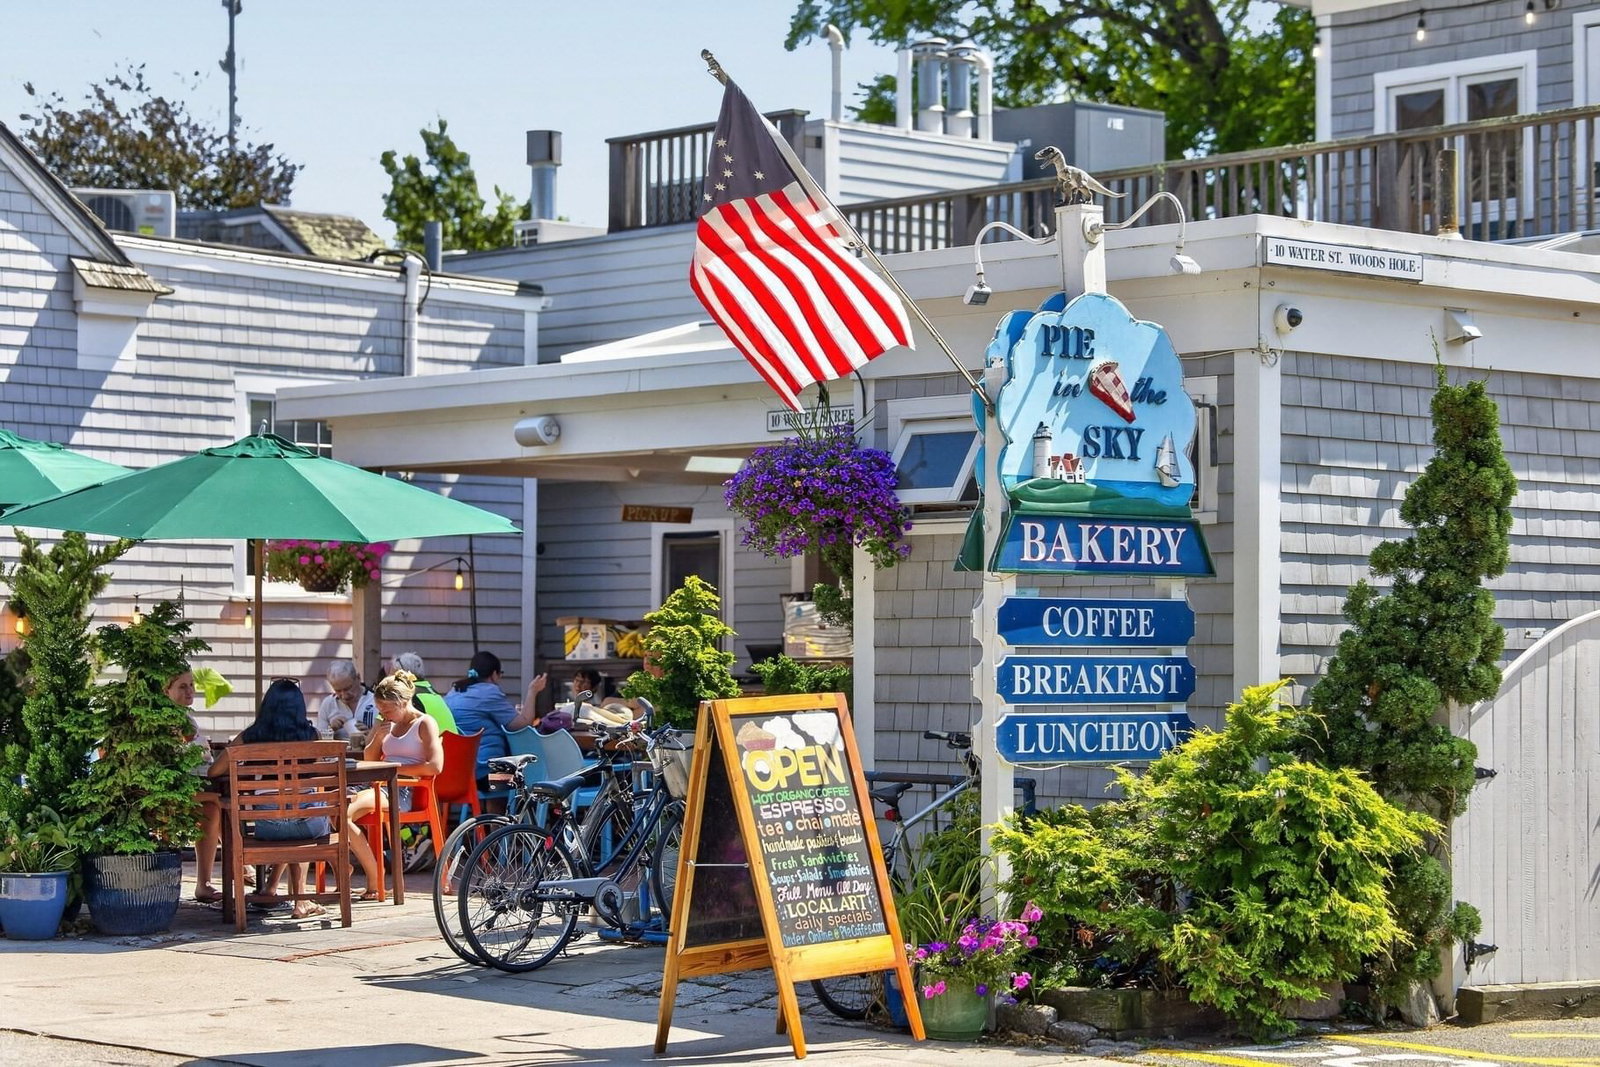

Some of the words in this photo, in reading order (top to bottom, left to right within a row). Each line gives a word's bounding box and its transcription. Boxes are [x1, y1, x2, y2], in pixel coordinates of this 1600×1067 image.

[1275, 245, 1285, 257] 10
[1288, 246, 1325, 262] WATER
[1328, 252, 1344, 264] ST.
[1349, 253, 1386, 269] WOODS
[1389, 257, 1416, 273] HOLE
[1041, 323, 1095, 360] PIE
[1053, 371, 1084, 398] in
[1131, 377, 1168, 405] the
[771, 414, 781, 427] 10
[1082, 424, 1145, 461] SKY
[1020, 522, 1187, 566] BAKERY
[1042, 606, 1156, 638] COFFEE
[1012, 664, 1182, 695] BREAKFAST
[1016, 721, 1179, 754] LUNCHEON
[746, 745, 846, 791] OPEN
[751, 792, 775, 806] HOT
[776, 788, 816, 801] ORGANIC
[816, 786, 851, 798] COFFEE
[760, 797, 847, 819] ESPRESSO
[757, 820, 785, 837] tea
[795, 814, 824, 831] chai
[761, 835, 806, 854] handmade
[771, 855, 798, 871] Fresh
[801, 851, 860, 867] Sandwiches
[828, 864, 870, 879] Smoothies
[777, 886, 802, 903] Full
[852, 880, 872, 896] Day
[786, 897, 839, 919] LOCAL
[840, 894, 867, 912] ART
[795, 915, 823, 933] daily
[827, 911, 873, 927] specials
[782, 933, 806, 947] Order
[807, 929, 834, 943] Online
